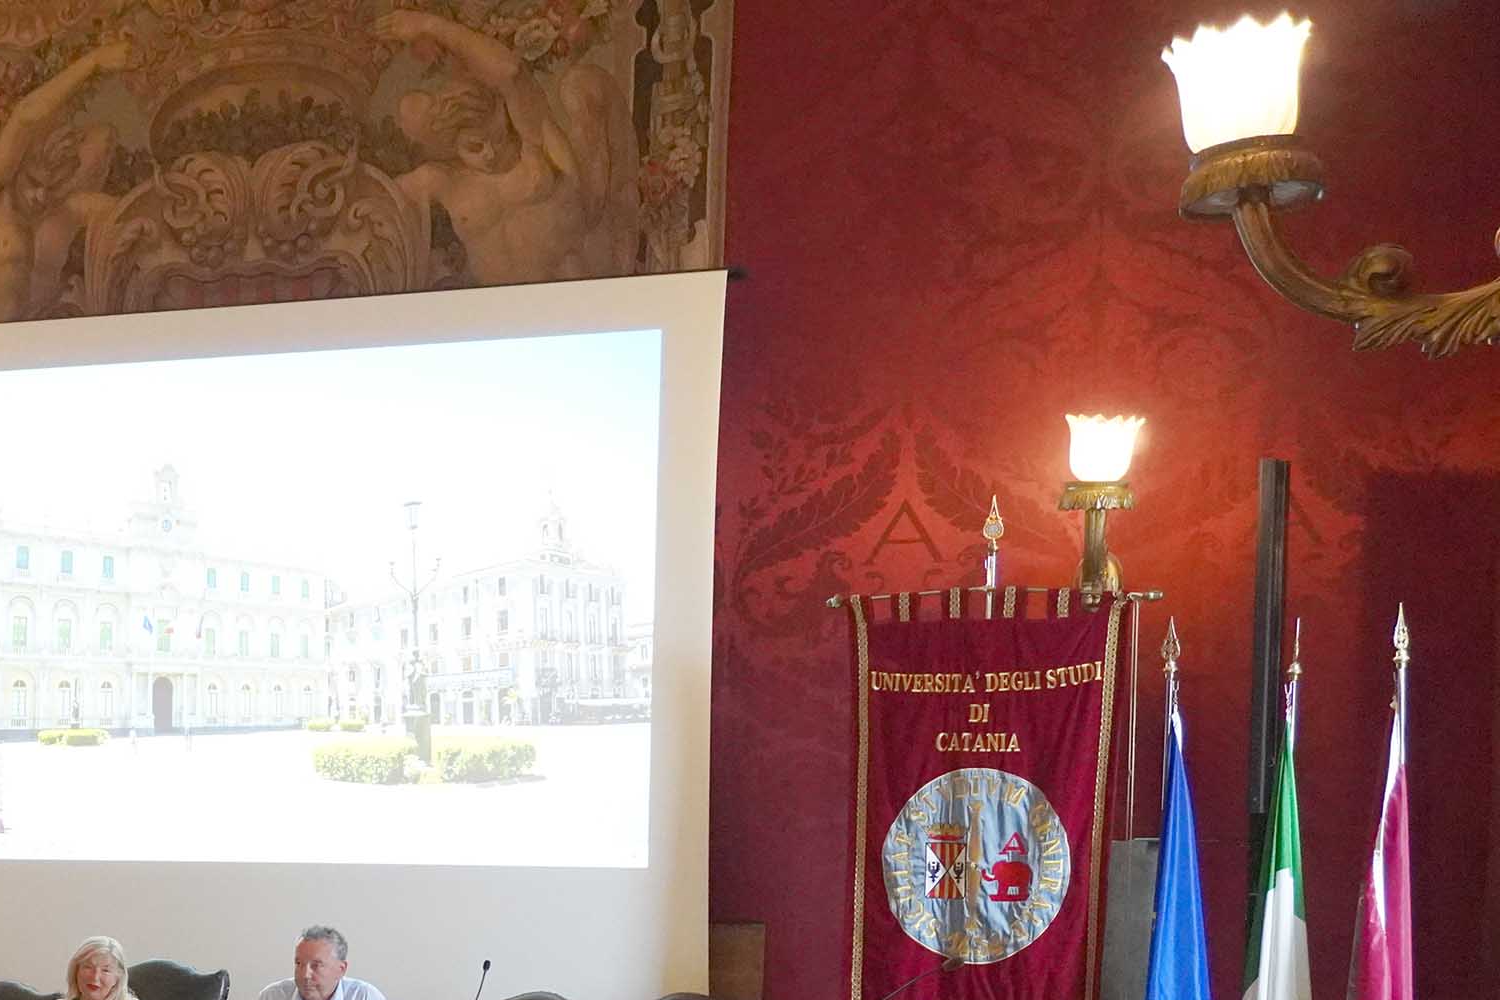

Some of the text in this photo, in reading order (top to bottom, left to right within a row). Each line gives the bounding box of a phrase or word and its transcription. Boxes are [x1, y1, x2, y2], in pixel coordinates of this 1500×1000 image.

[985, 671, 1041, 692] DEGLI
[1046, 661, 1102, 688] STUDI
[968, 704, 989, 722] DI
[935, 732, 1021, 752] CATANIA
